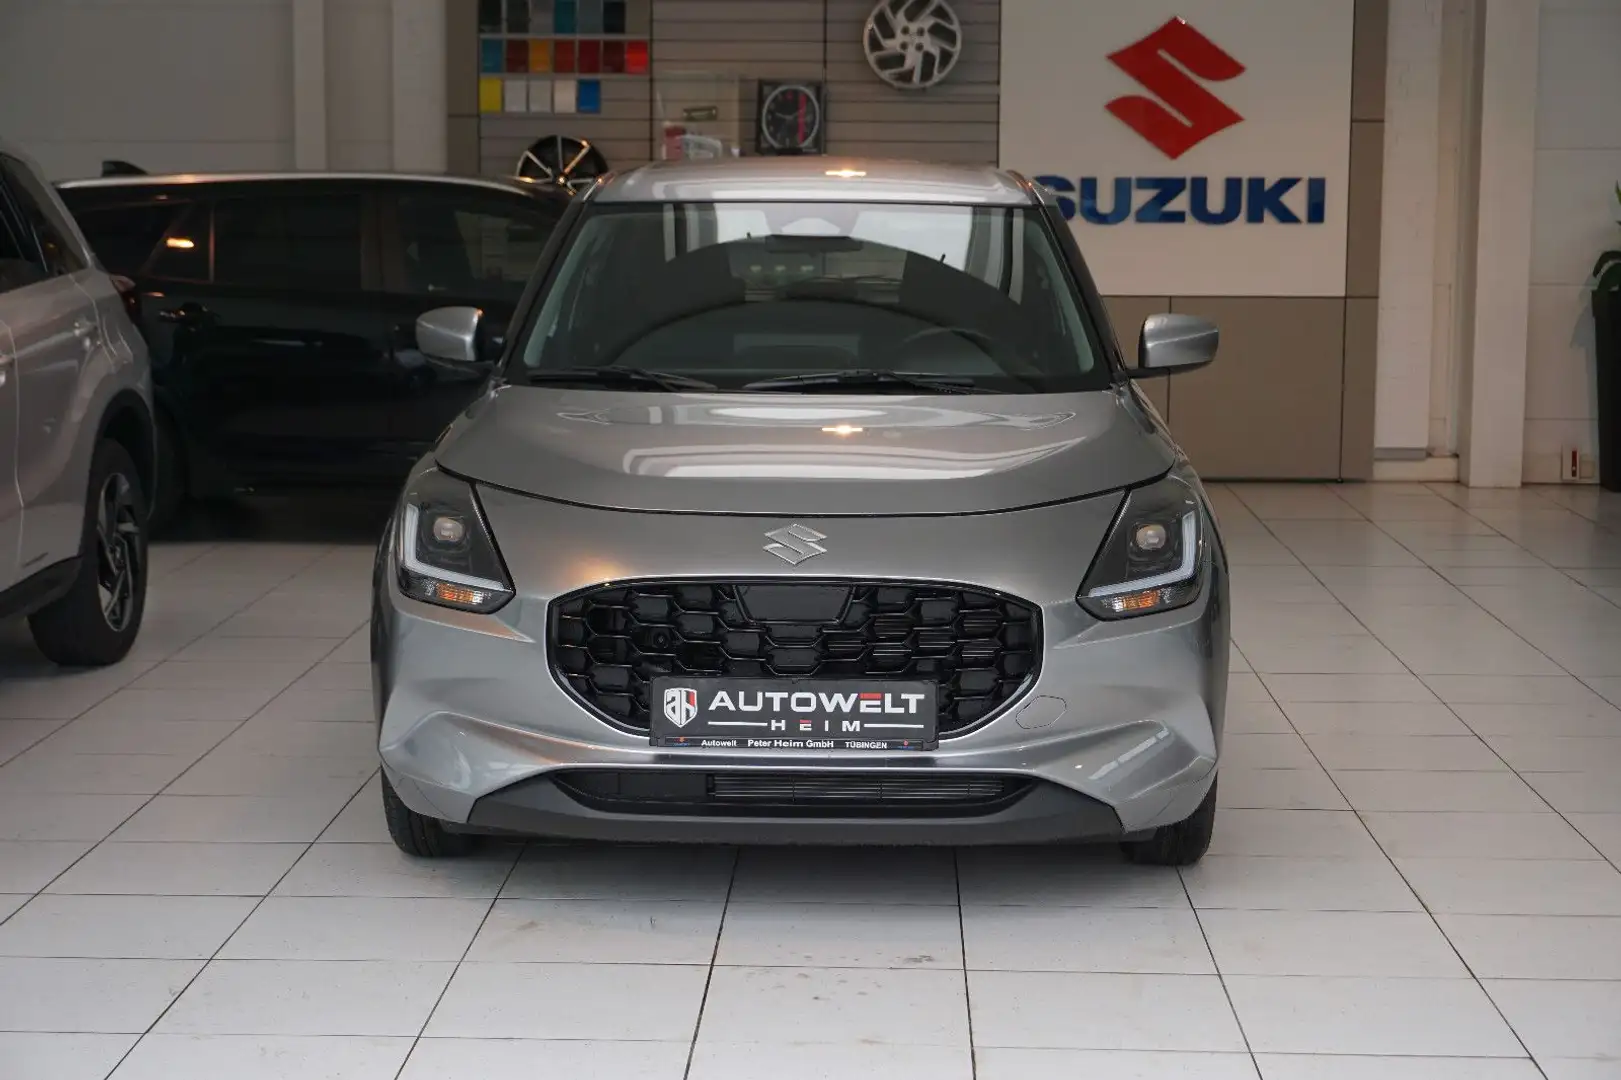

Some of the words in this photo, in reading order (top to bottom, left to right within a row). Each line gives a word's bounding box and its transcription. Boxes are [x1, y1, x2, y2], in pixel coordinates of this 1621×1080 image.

[708, 690, 925, 714] AUTOWELT
[770, 719, 861, 732] HEIM
[701, 739, 737, 747] Autowelt
[747, 739, 772, 747] Peter
[774, 739, 804, 747] Heim
[806, 740, 834, 748] GmbH
[845, 740, 888, 749] TÜBINGEN
